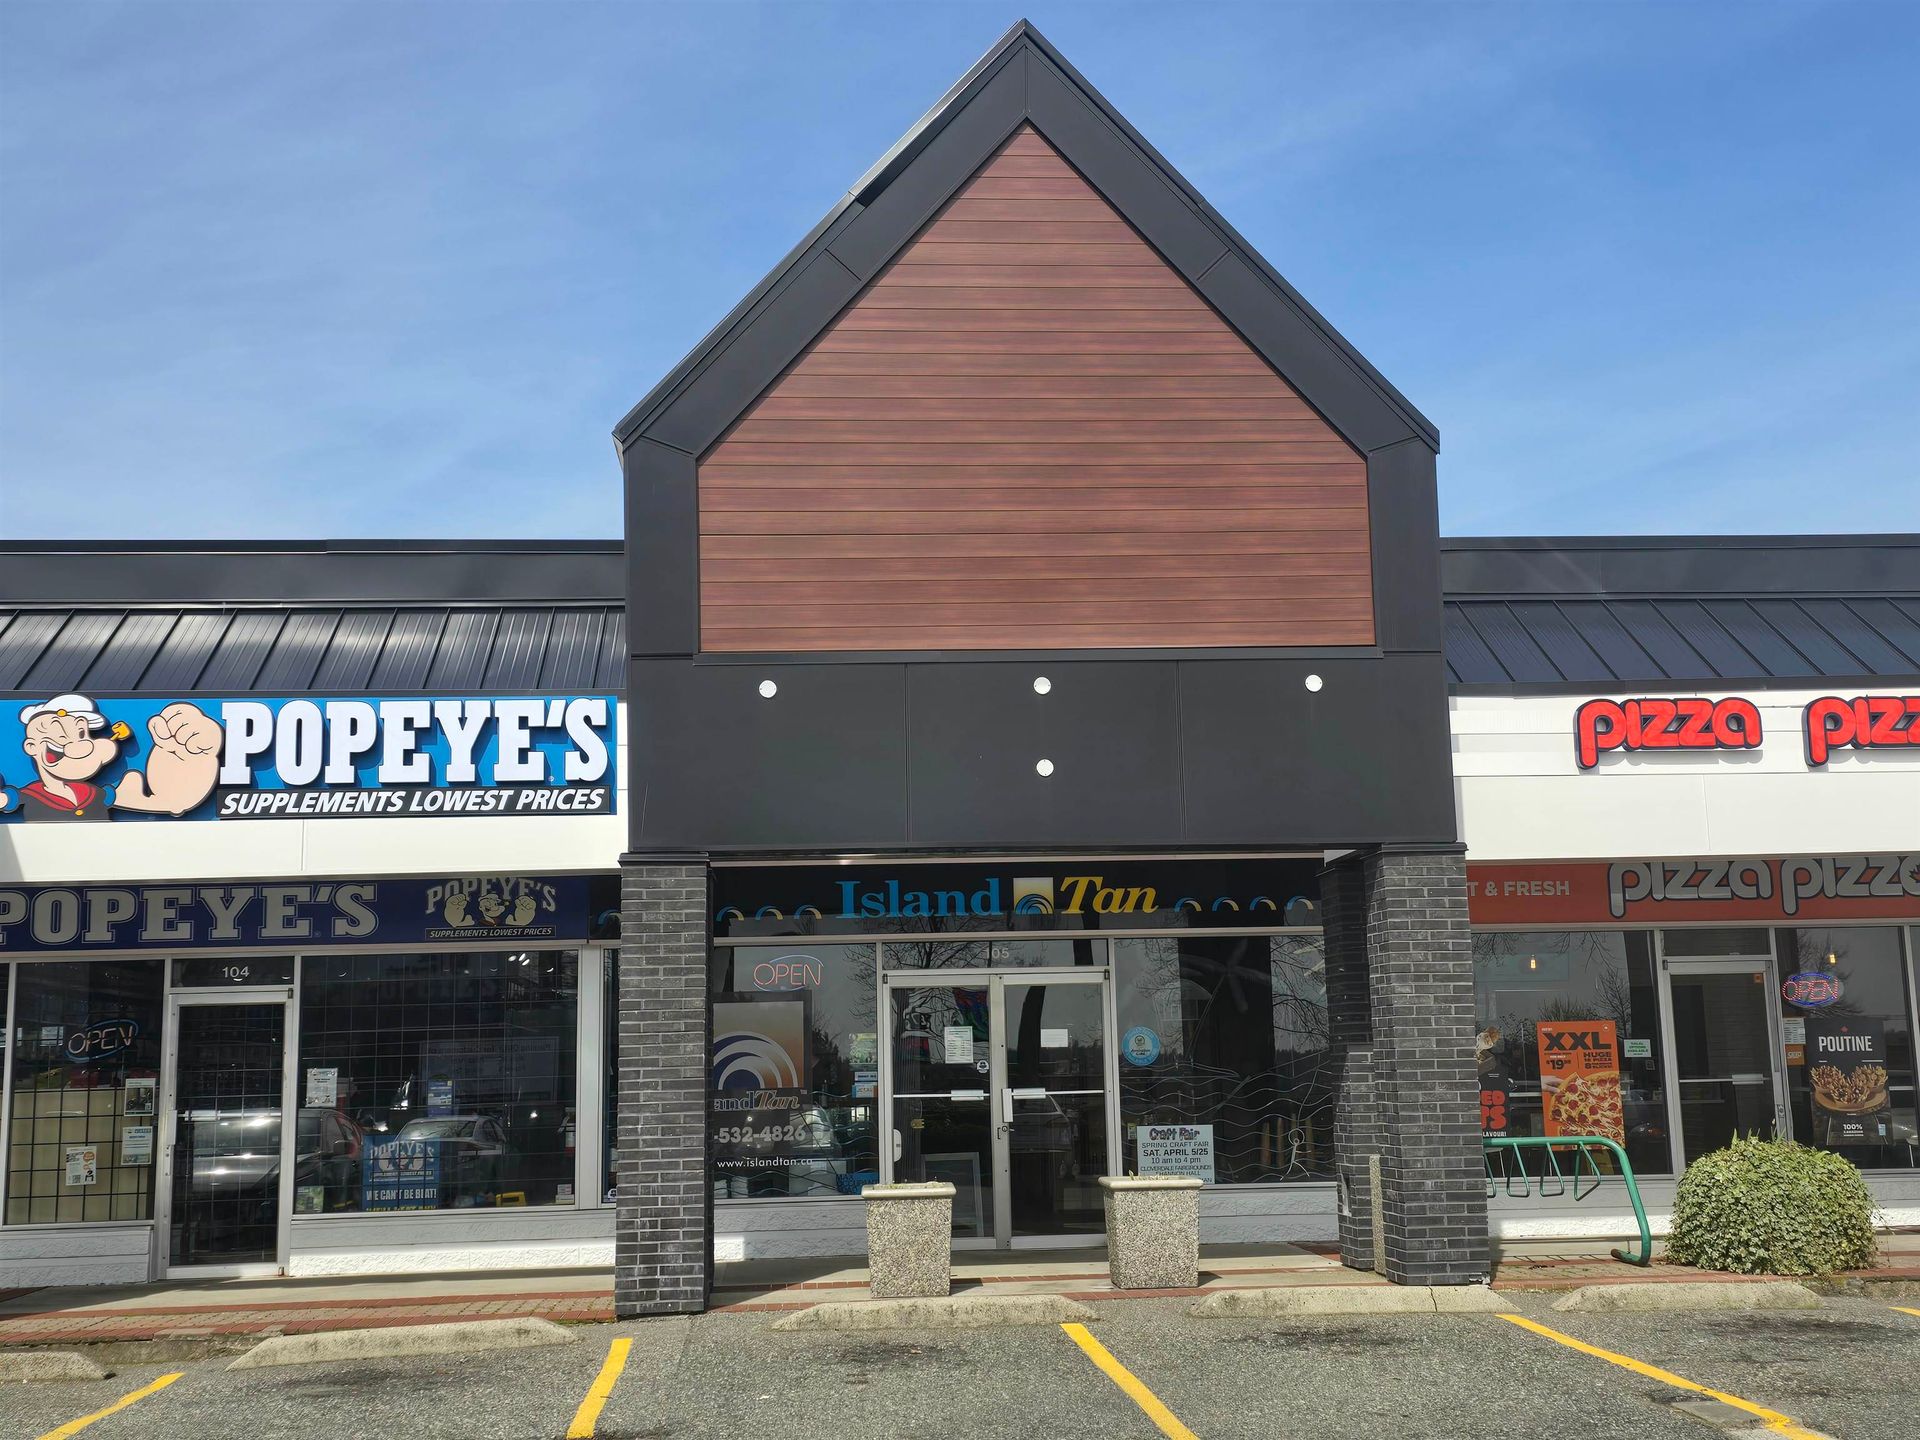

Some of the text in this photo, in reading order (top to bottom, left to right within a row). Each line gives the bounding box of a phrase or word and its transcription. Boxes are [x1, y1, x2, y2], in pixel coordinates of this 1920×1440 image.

[219, 698, 608, 785] POPEYE'S
[1574, 697, 1763, 769] pizza
[220, 788, 605, 814] SUPPLEMENTS LOWEST PRICES
[425, 876, 557, 914] POPEYE'S
[835, 876, 1158, 919] Island Tan
[1485, 881, 1498, 896] &
[1504, 880, 1570, 896] FRESH
[1608, 860, 1774, 918] pizza
[0, 882, 379, 945] POPEYE'S
[430, 927, 552, 938] SUPPLEMENTS LOWEST PRICES
[221, 965, 250, 979] 104
[754, 963, 822, 987] OPEN
[1783, 975, 1839, 1001] OPEN
[68, 1025, 134, 1055] OPEN
[1542, 1032, 1612, 1051] XXL
[1818, 1035, 1873, 1052] POUTINE
[1149, 1127, 1200, 1140] Craft Fair
[1143, 1149, 1161, 1157] SAT.
[1191, 1148, 1209, 1156] 5/25
[404, 1189, 414, 1199] BE
